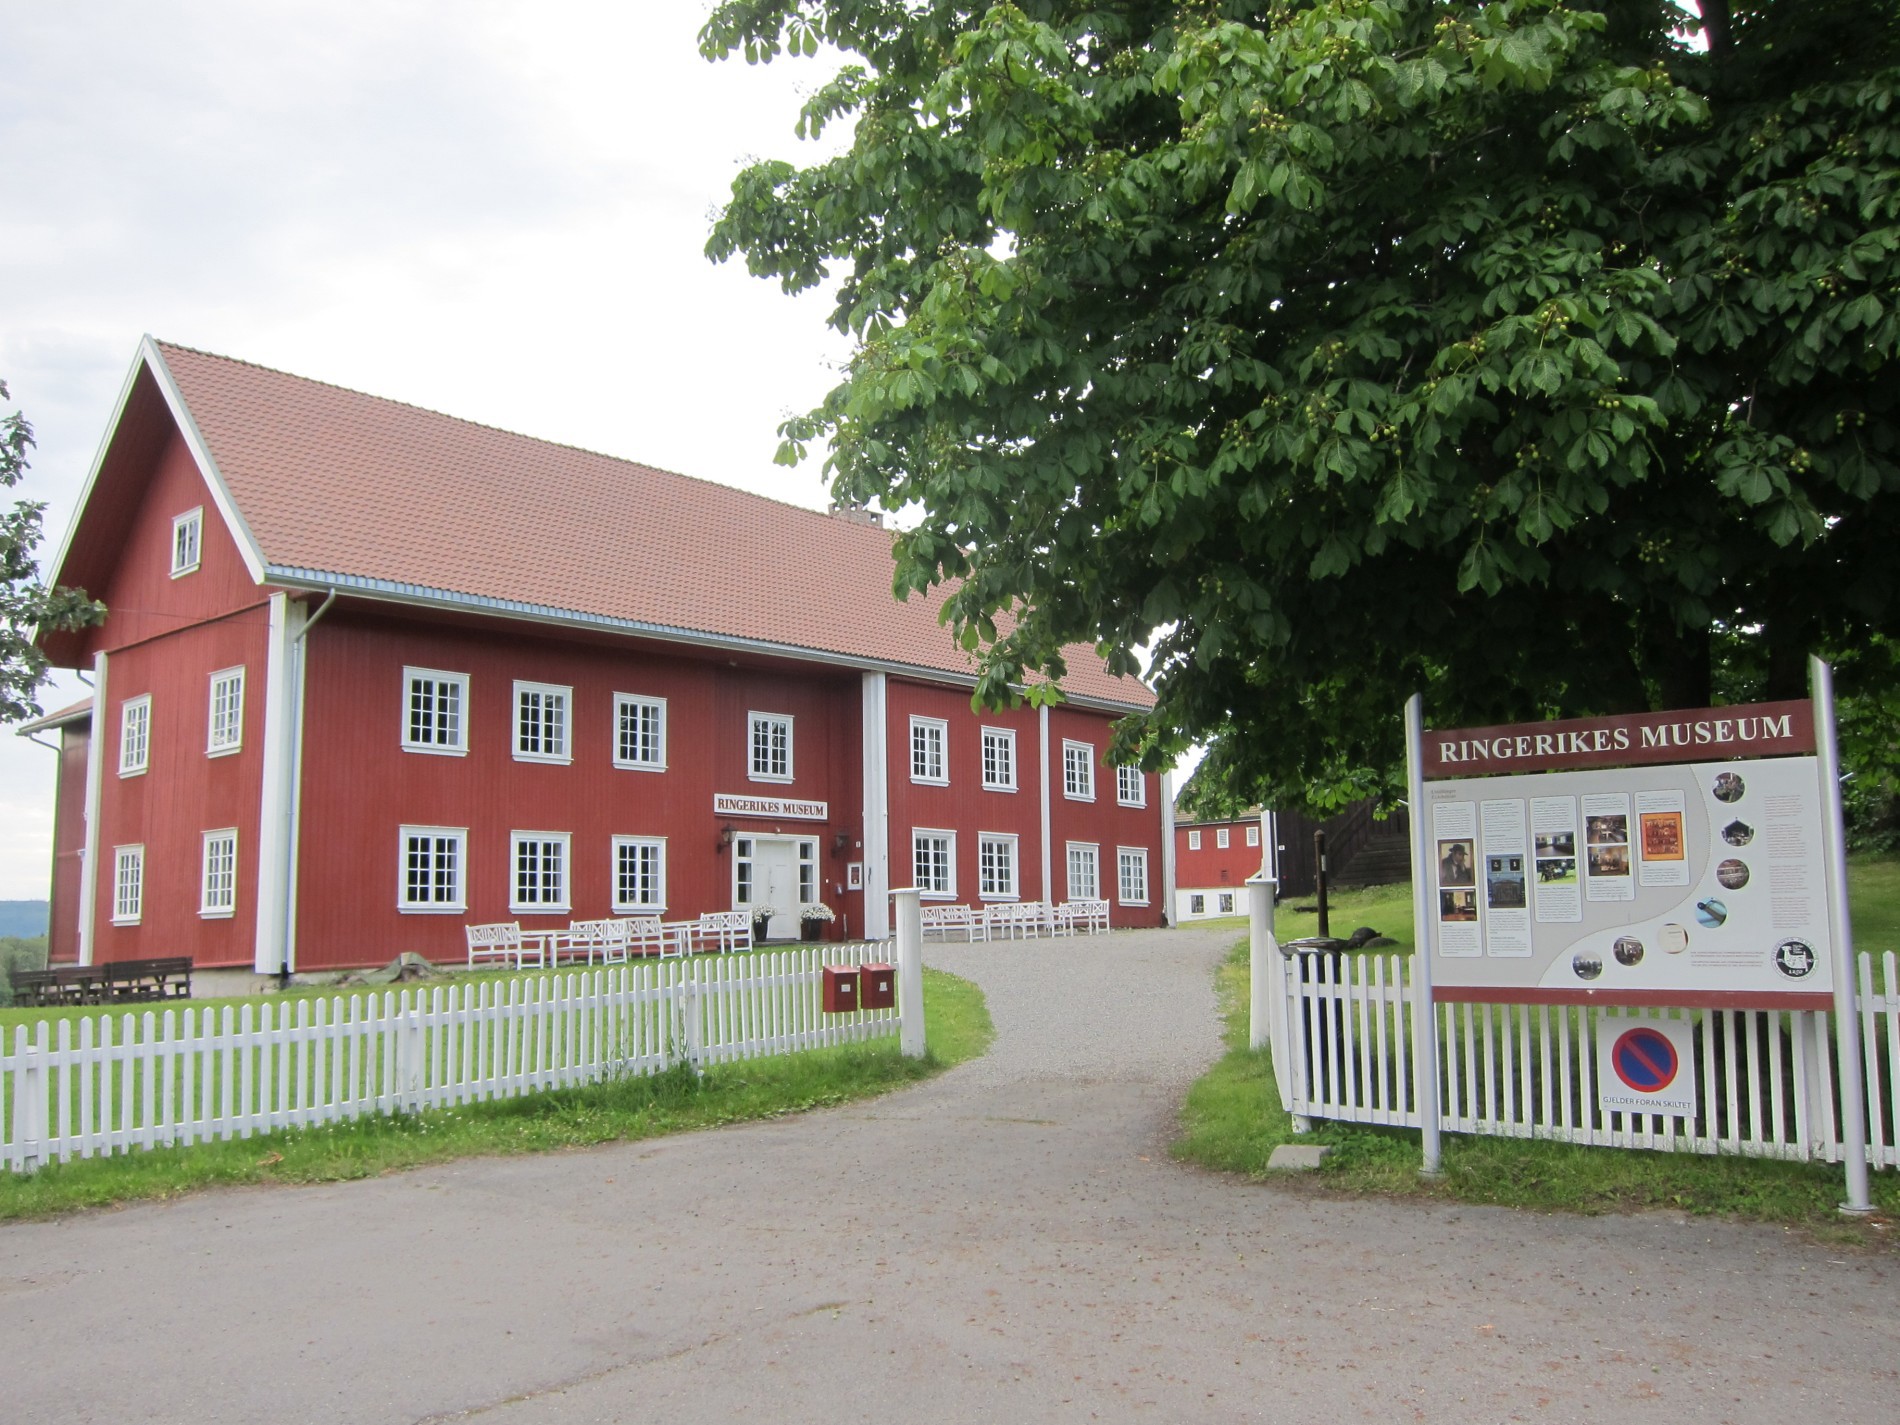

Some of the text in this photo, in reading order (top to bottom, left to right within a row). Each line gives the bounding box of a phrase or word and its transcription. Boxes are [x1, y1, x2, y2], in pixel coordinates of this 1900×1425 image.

[1439, 714, 1794, 763] RINGERIKES MUSEUM
[717, 798, 824, 816] RINGERIKES MUSEUM
[1603, 1096, 1692, 1109] GJELDER FORAN SKILTET
